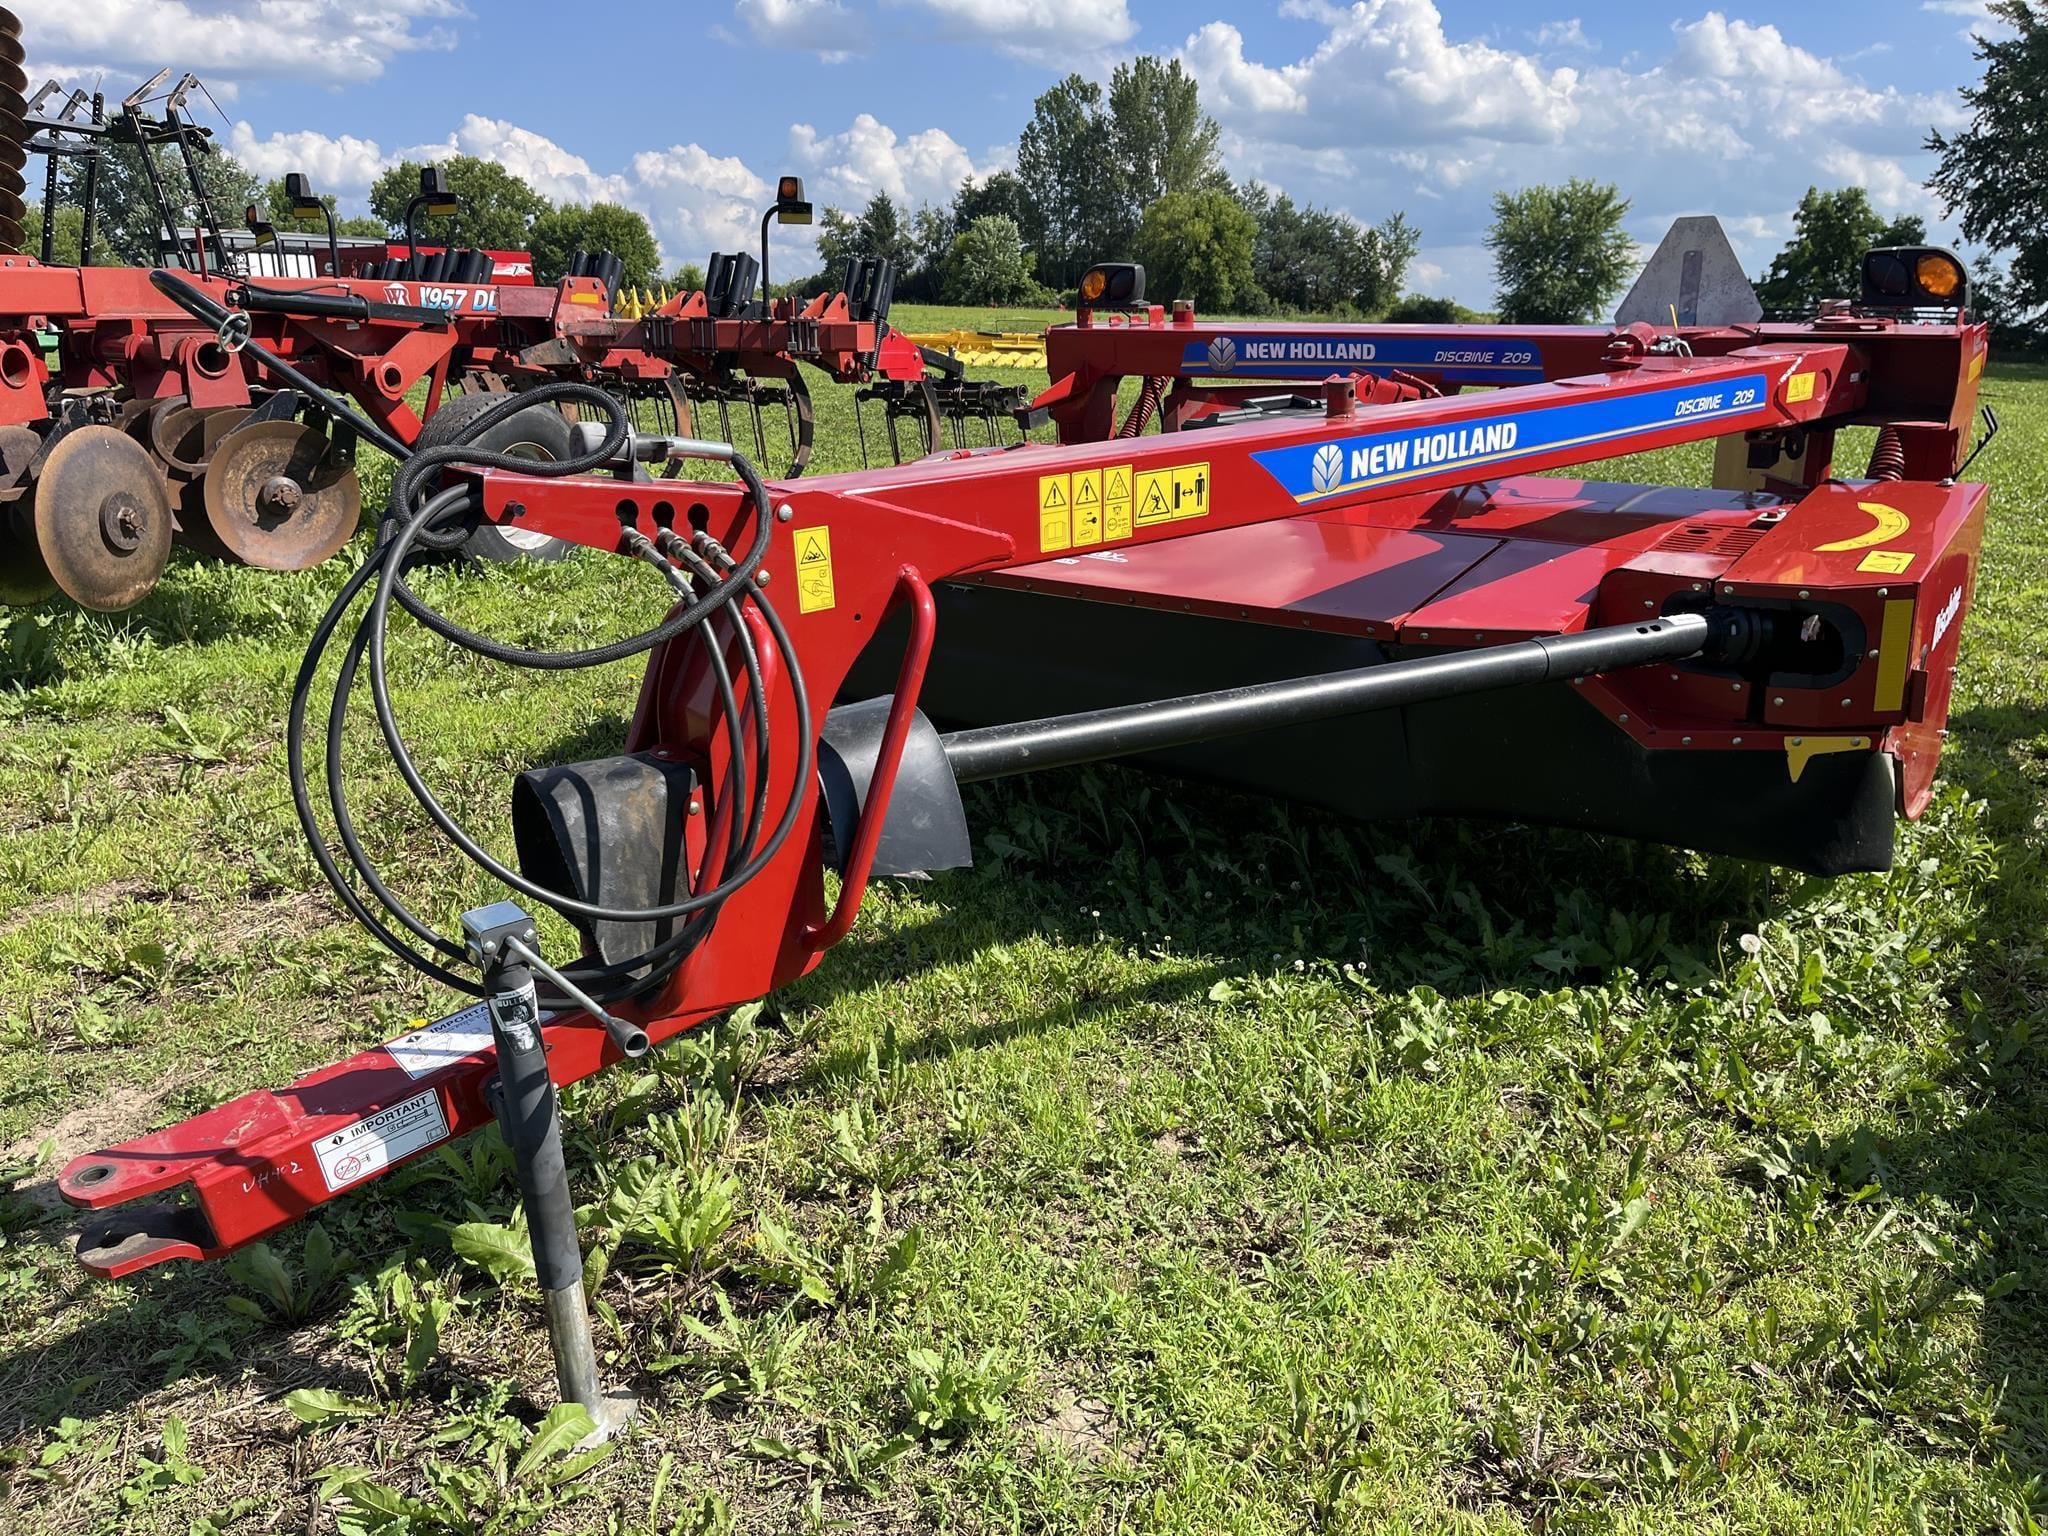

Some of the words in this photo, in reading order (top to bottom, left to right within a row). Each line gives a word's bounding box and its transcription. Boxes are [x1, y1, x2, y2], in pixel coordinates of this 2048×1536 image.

[1245, 342, 1287, 360] NEW
[1289, 342, 1376, 361] HOLLAND
[1434, 350, 1494, 364] DISCBINE
[1501, 351, 1532, 364] 209
[1675, 395, 1722, 417] DISCBINE
[1732, 388, 1756, 405] 209
[1351, 440, 1409, 480] NEW
[1413, 422, 1518, 467] HOLLAND
[350, 1095, 429, 1138] IMPORTANT
